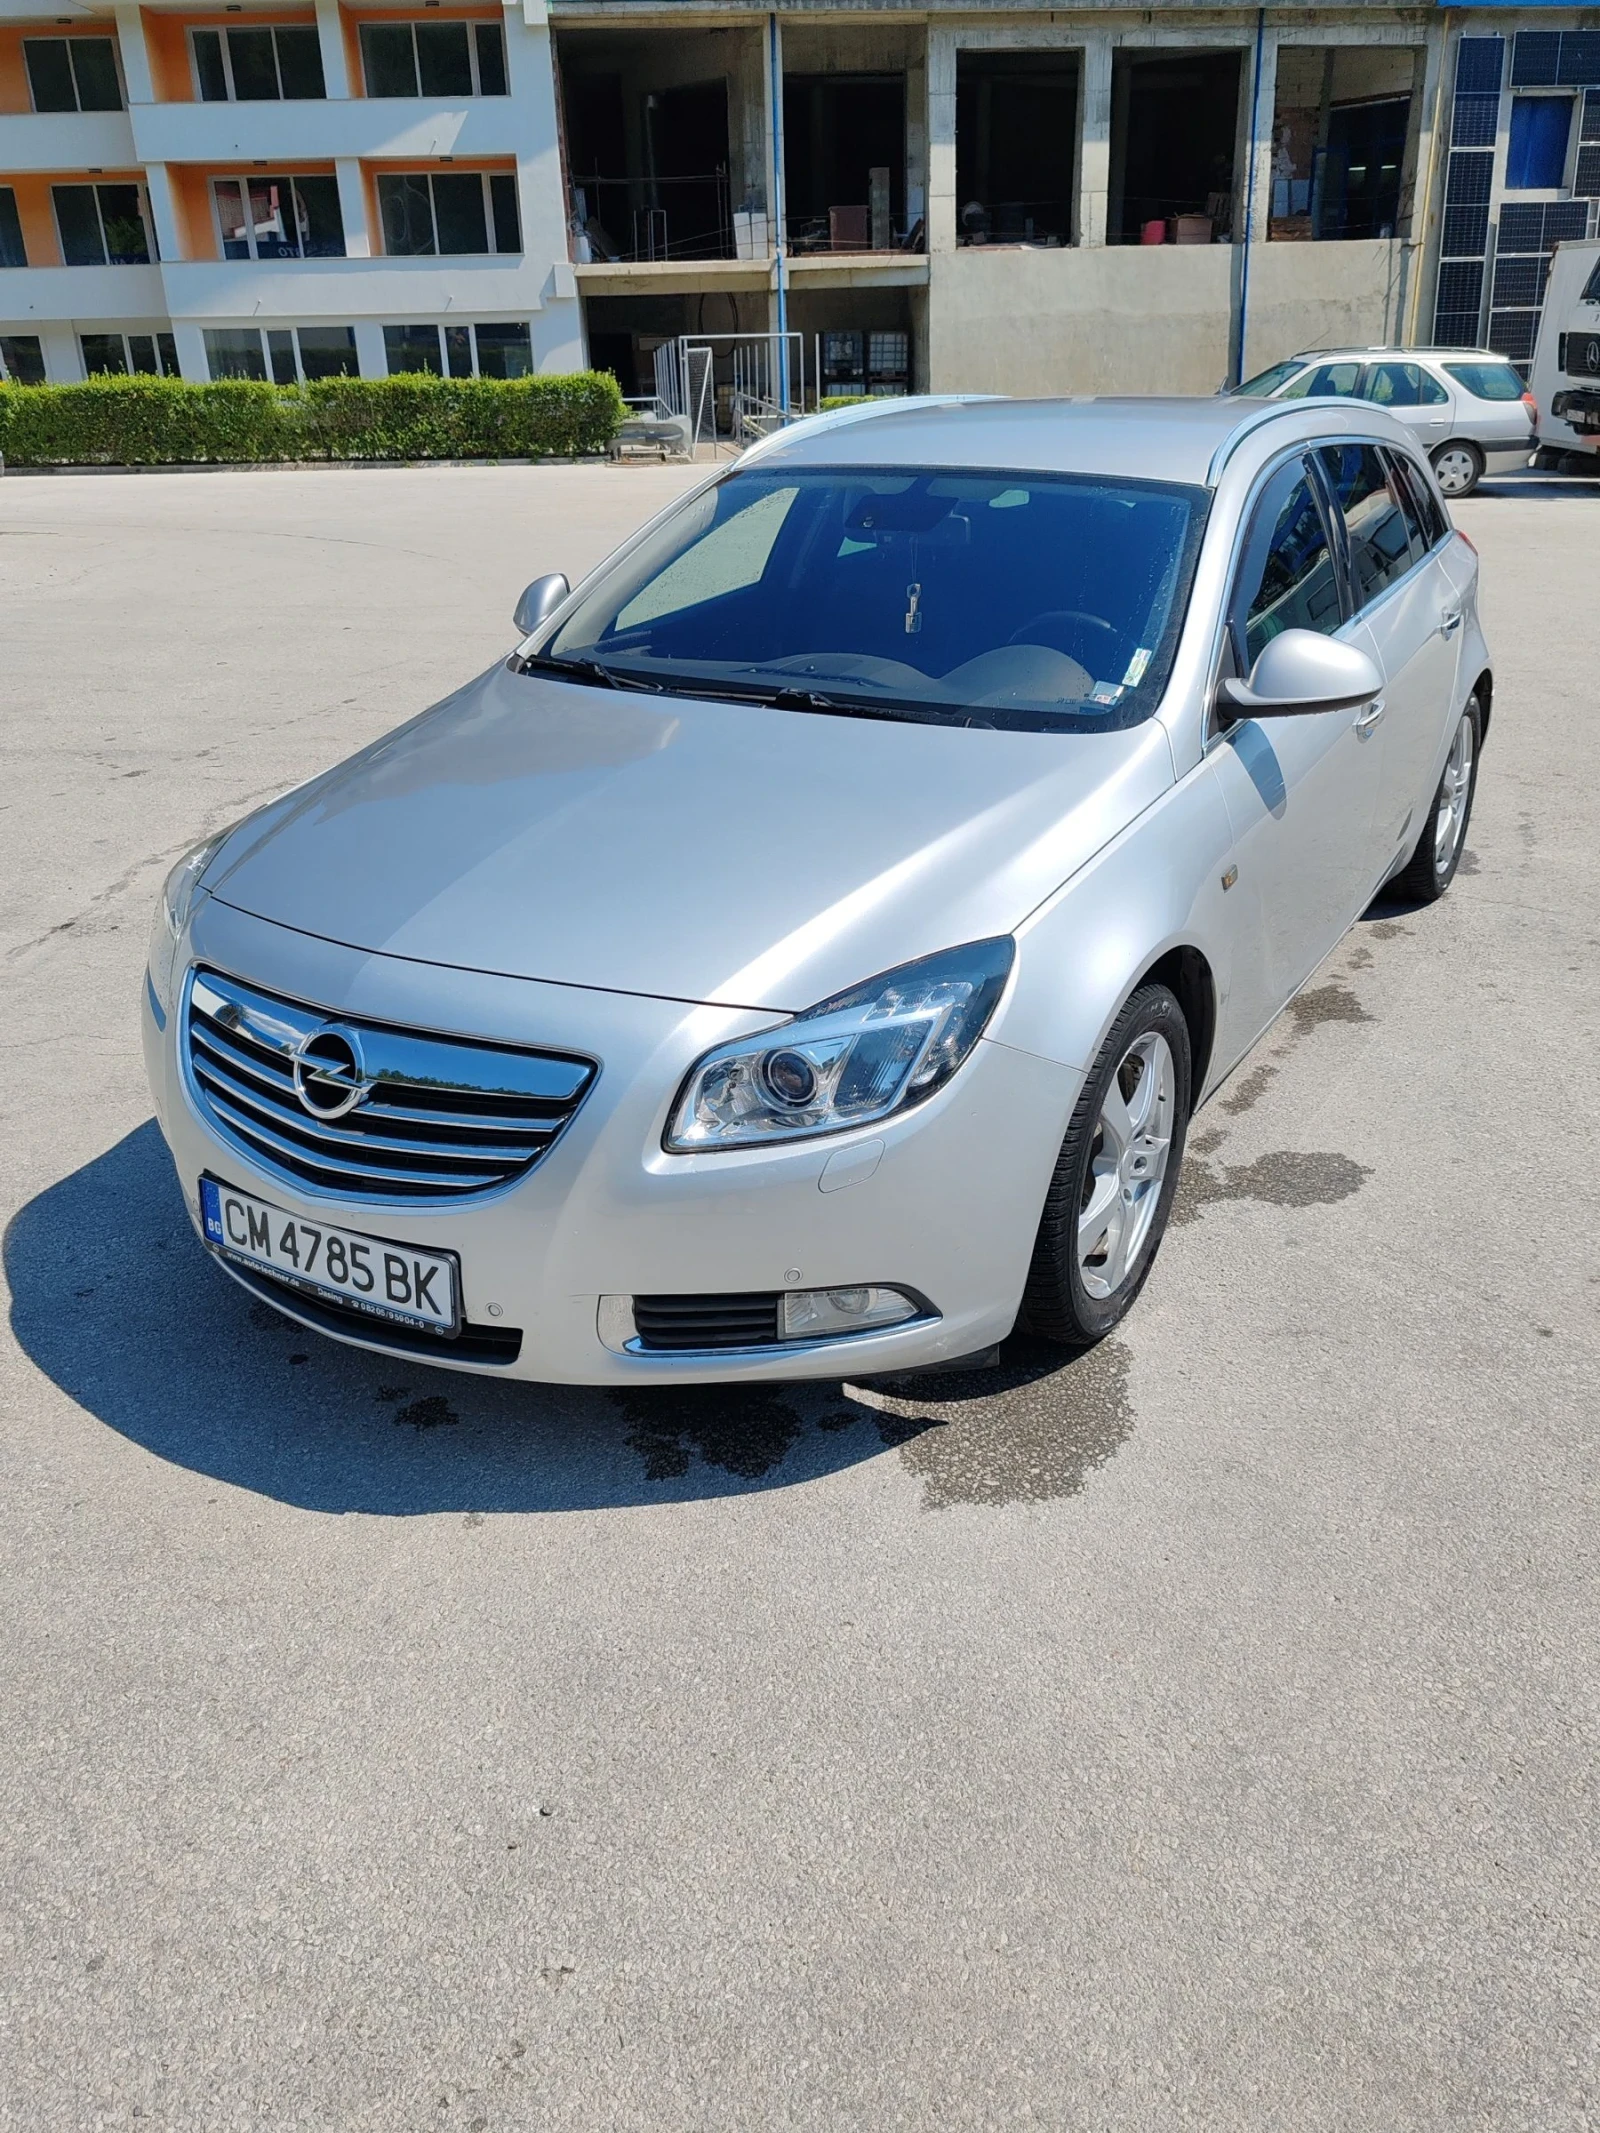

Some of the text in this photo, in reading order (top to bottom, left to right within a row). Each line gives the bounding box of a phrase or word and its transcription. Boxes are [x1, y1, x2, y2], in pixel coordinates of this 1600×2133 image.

[207, 1217, 222, 1235] BG
[225, 1198, 442, 1316] CM 4785 BK
[317, 1287, 343, 1304] Dasing
